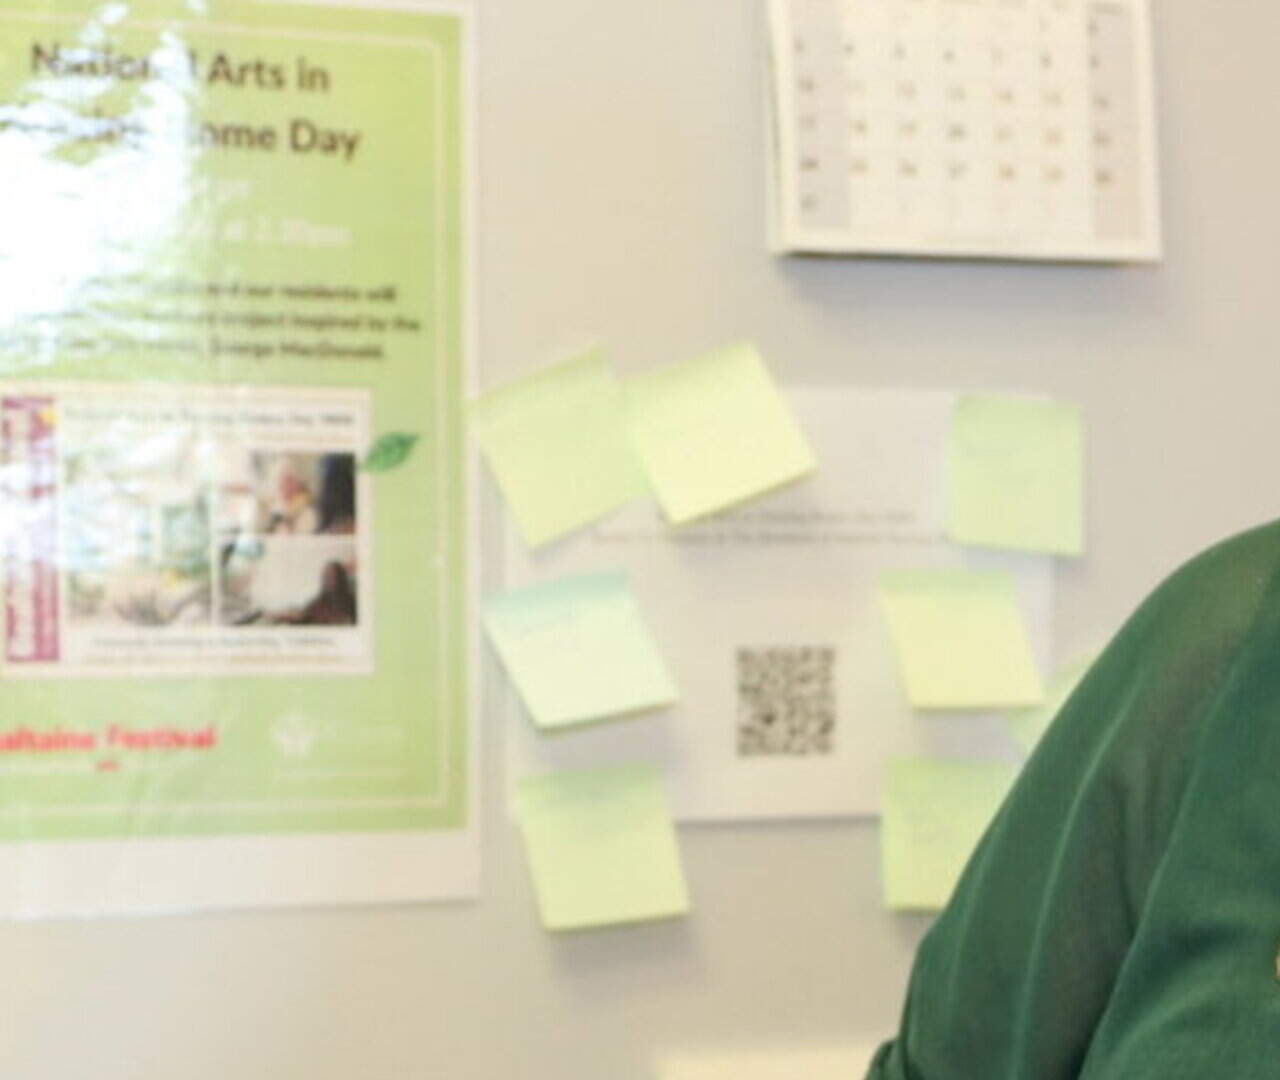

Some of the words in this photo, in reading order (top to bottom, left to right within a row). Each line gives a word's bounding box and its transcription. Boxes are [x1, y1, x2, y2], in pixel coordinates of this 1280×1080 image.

[207, 53, 286, 90] Arts
[297, 57, 331, 92] in
[192, 117, 277, 151] ome
[289, 118, 362, 162] Day
